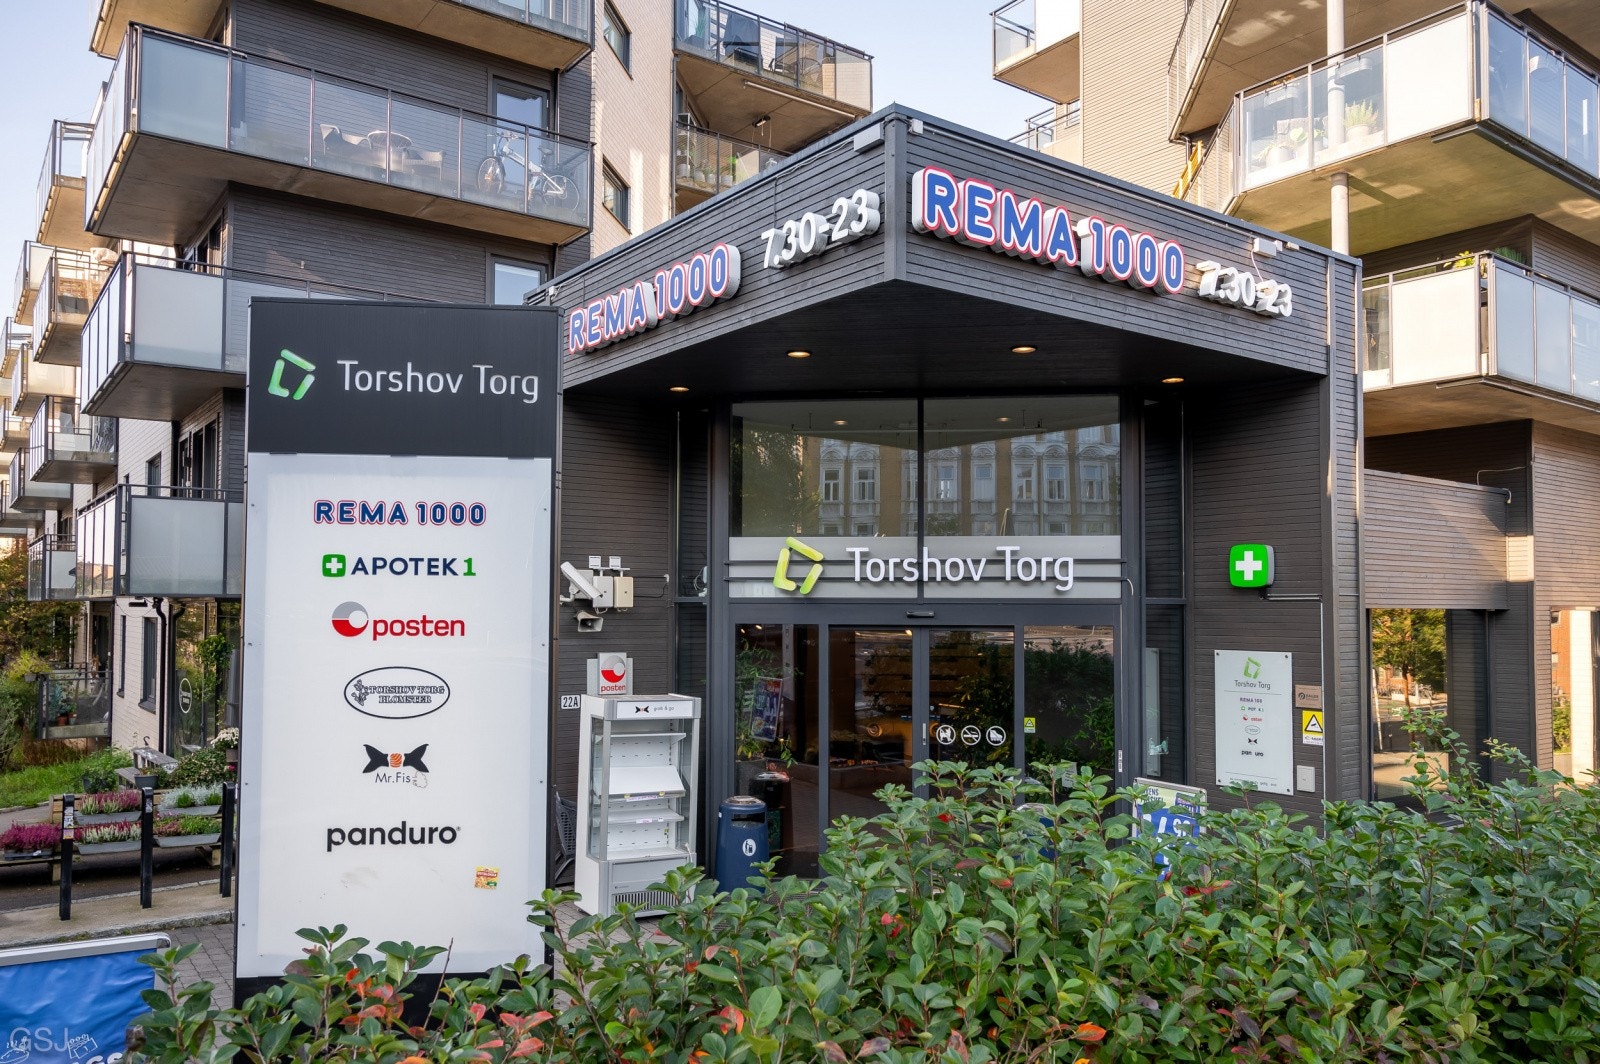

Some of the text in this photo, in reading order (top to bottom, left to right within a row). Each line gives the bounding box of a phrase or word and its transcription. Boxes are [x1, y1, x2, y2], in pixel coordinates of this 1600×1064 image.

[761, 188, 870, 269] 7.30-23
[923, 166, 1185, 294] REMA 1000
[569, 242, 731, 354] REMA 1000
[337, 359, 539, 404] Torshov Torg
[314, 500, 487, 527] REMA 1000
[351, 557, 458, 576] APOTEK
[845, 545, 1075, 591] Torshov Torg
[373, 615, 465, 641] posten
[369, 685, 445, 694] TORSHOV TORG
[378, 695, 432, 704] BLOMSTER
[562, 696, 579, 707] 22A
[601, 684, 626, 693] posten
[375, 772, 414, 784] Mr.Fis
[327, 820, 458, 852] panduro
